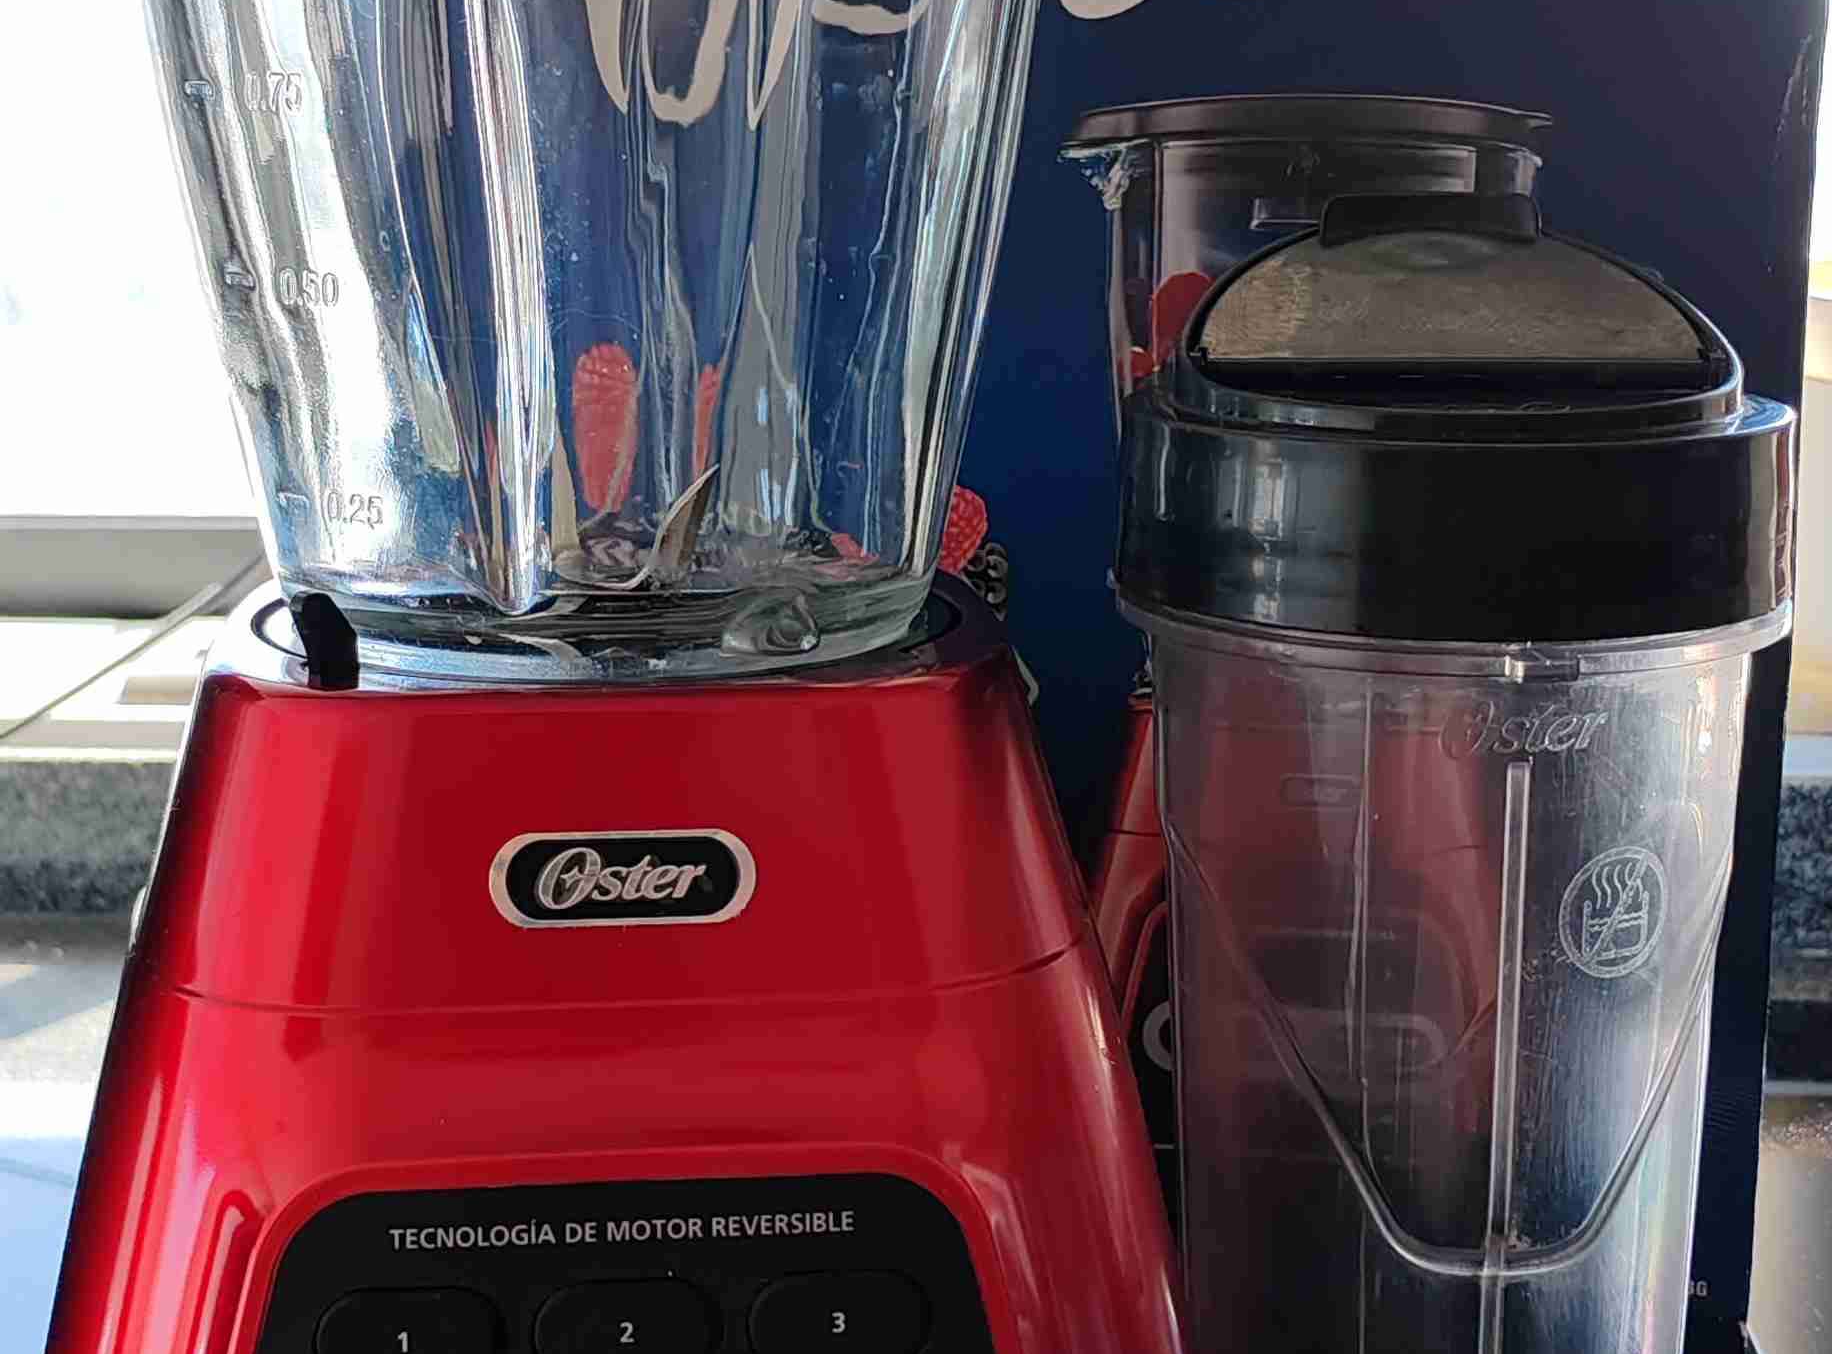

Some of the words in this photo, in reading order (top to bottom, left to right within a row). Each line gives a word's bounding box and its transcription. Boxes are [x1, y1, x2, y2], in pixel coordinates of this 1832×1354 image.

[277, 268, 340, 307] 0.50
[326, 488, 384, 529] 0.25
[1437, 699, 1610, 761] Oster
[536, 846, 708, 911] Oster
[388, 1219, 556, 1250] TECNOLOGÍA
[565, 1221, 597, 1244] DE
[606, 1217, 703, 1242] MOTOR
[711, 1210, 854, 1238] REVERSIBLE
[397, 1331, 408, 1353] 1
[619, 1321, 635, 1343] 2
[831, 1311, 846, 1334] 3
